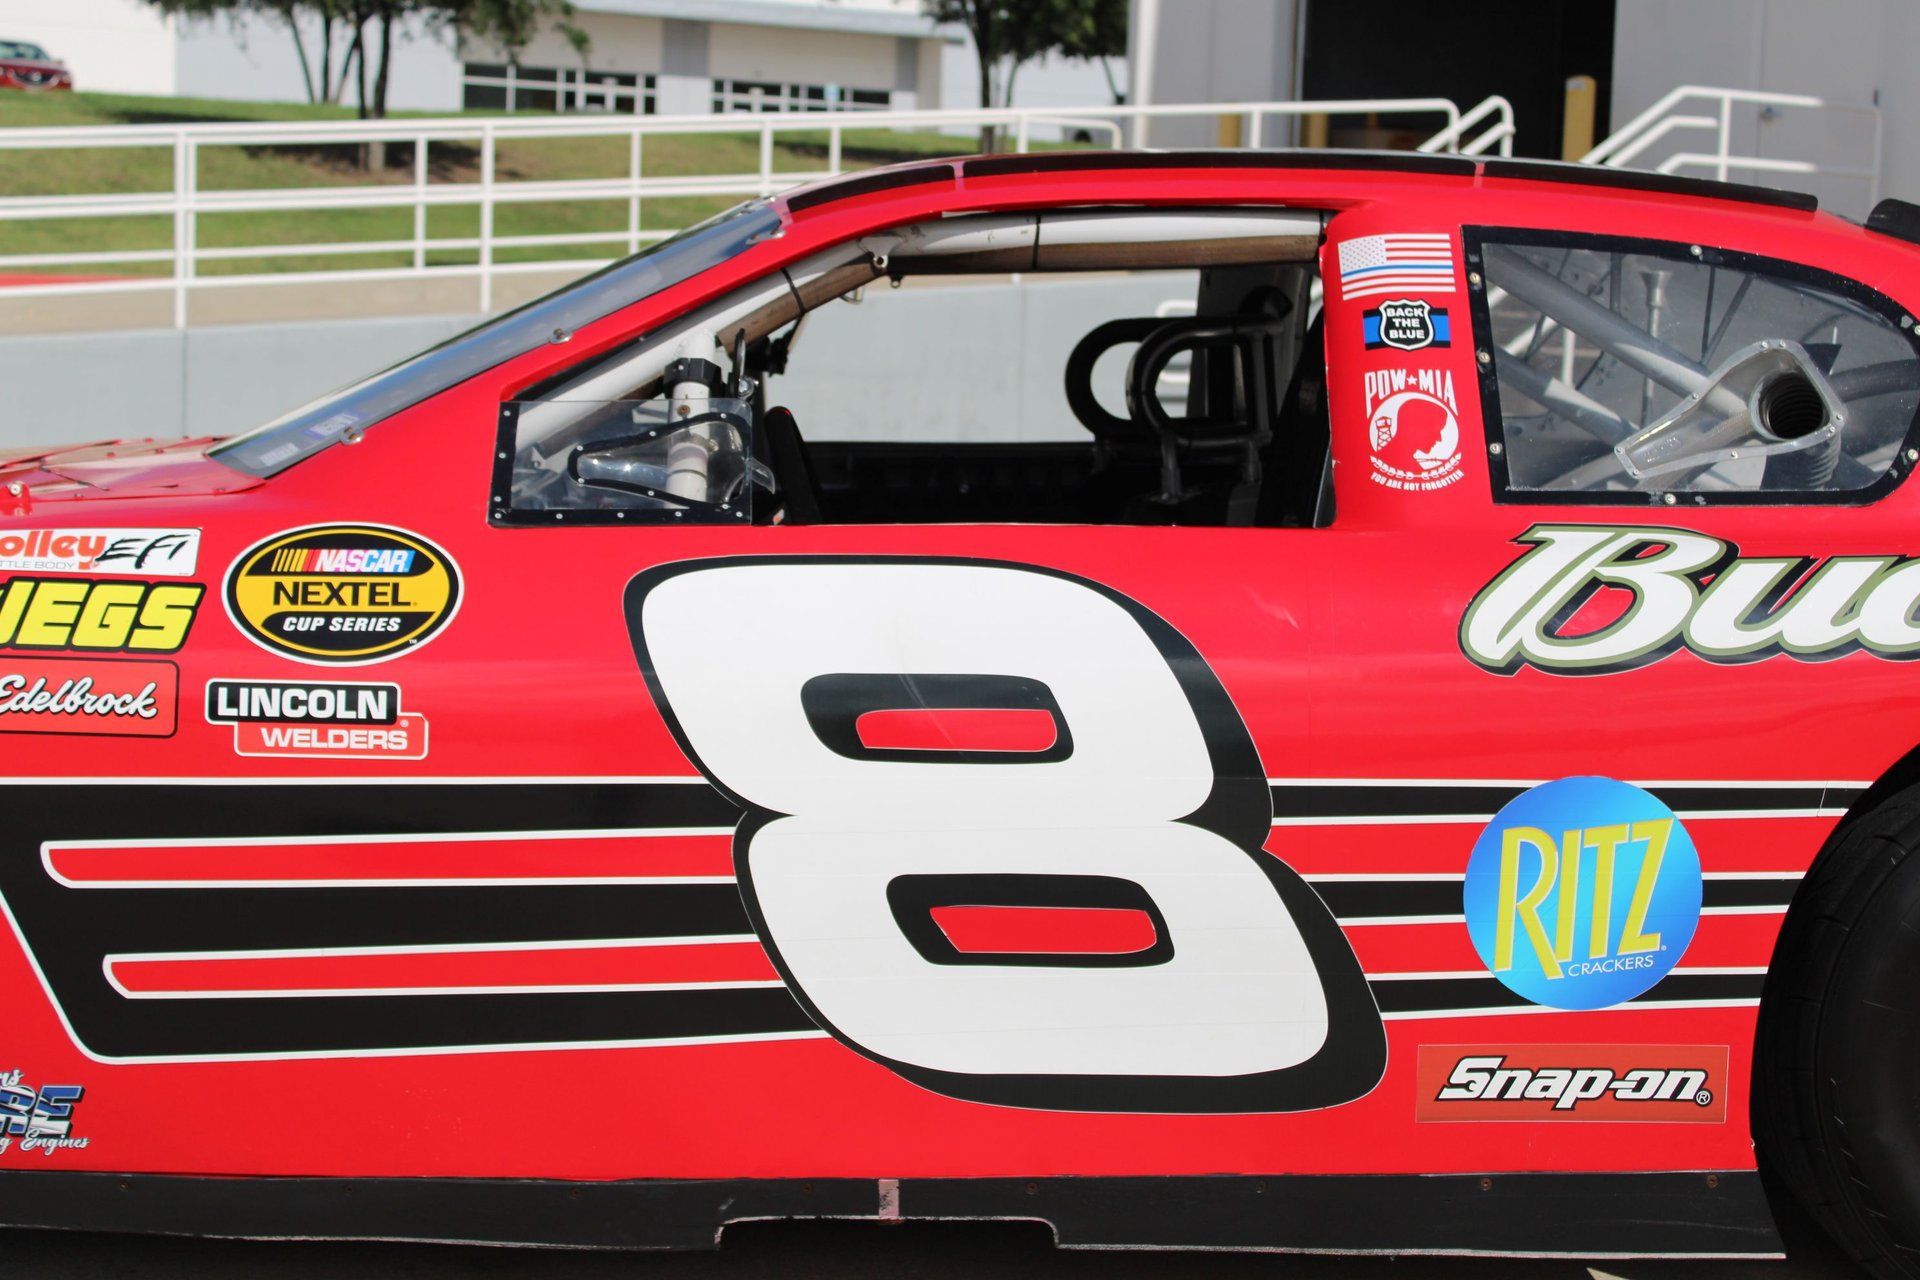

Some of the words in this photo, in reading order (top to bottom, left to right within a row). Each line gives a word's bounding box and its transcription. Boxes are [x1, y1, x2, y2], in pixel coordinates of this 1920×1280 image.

[1386, 307, 1424, 317] BACK
[1392, 318, 1420, 328] THE
[1389, 329, 1426, 339] BLUE
[1364, 368, 1407, 420] POW
[1418, 368, 1459, 417] MIA
[1370, 471, 1387, 486] YOU
[1385, 478, 1402, 490] ARE
[1403, 481, 1420, 491] NOT
[1421, 468, 1465, 492] FORGOTTEN
[95, 534, 191, 570] EFI
[313, 549, 410, 573] NASCAR
[34, 561, 76, 570] BODY
[273, 581, 412, 607] NEXTEL
[282, 616, 325, 632] CUP
[328, 617, 402, 632] SERIES
[0, 674, 158, 719] Edelbrock
[217, 686, 388, 720] LINCOLN
[260, 728, 408, 750] WELDERS
[625, 555, 1386, 1113] 8
[1494, 818, 1675, 980] RITZ
[1568, 954, 1655, 977] CRACKERS
[20, 1128, 90, 1156] Engines
